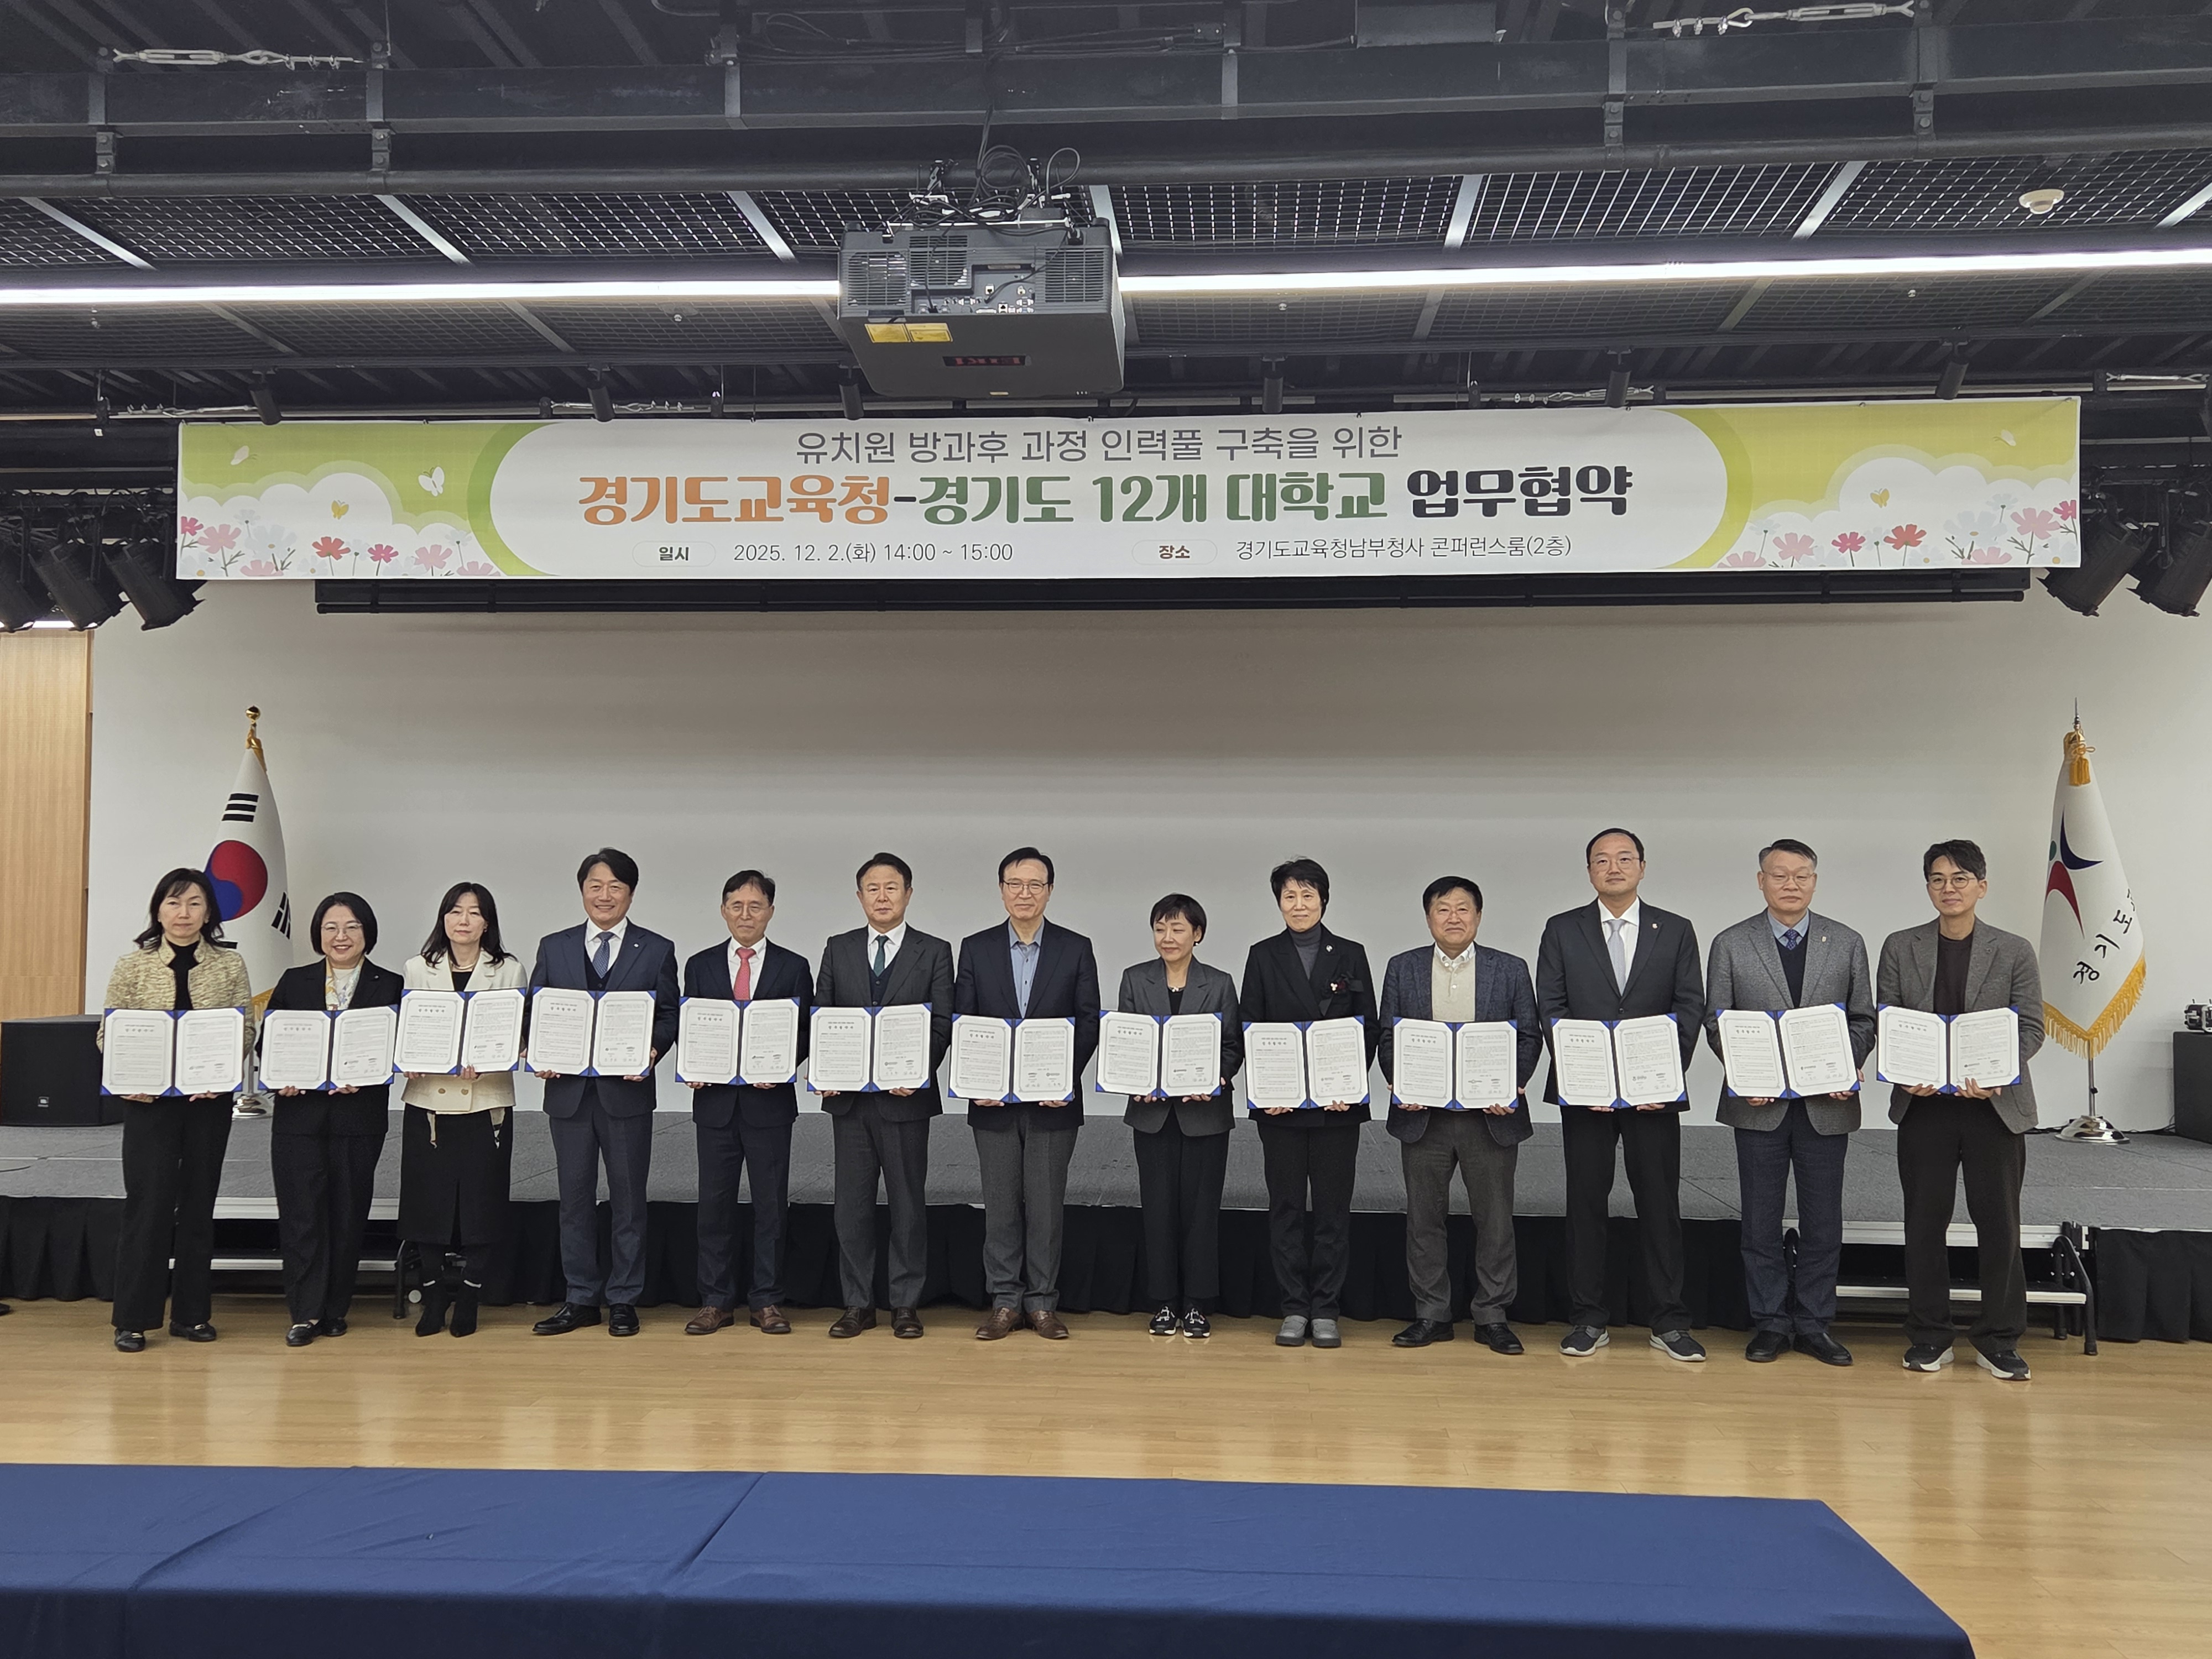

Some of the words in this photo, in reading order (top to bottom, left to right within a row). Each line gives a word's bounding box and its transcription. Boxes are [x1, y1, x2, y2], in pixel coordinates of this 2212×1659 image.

[796, 431, 895, 464] 유치원
[909, 430, 1009, 463] 방과후
[1021, 430, 1086, 462] 과정
[1101, 429, 1203, 461] 인력풀
[1216, 427, 1319, 461] 구축을
[1332, 425, 1402, 459] 위한
[1092, 474, 1207, 523] 12개
[1227, 472, 1388, 522] 대학교
[1407, 465, 1633, 518] 업무협약
[659, 546, 689, 561] 일시
[734, 544, 785, 561] 2025.
[795, 544, 820, 561] 12.
[884, 543, 936, 561] 14:00
[961, 544, 1013, 560] 15:00
[1159, 545, 1190, 560] 장소
[1236, 537, 1425, 560] 경기도교육청남부청사
[1430, 535, 1571, 557] 콘퍼런스룸(2층)
